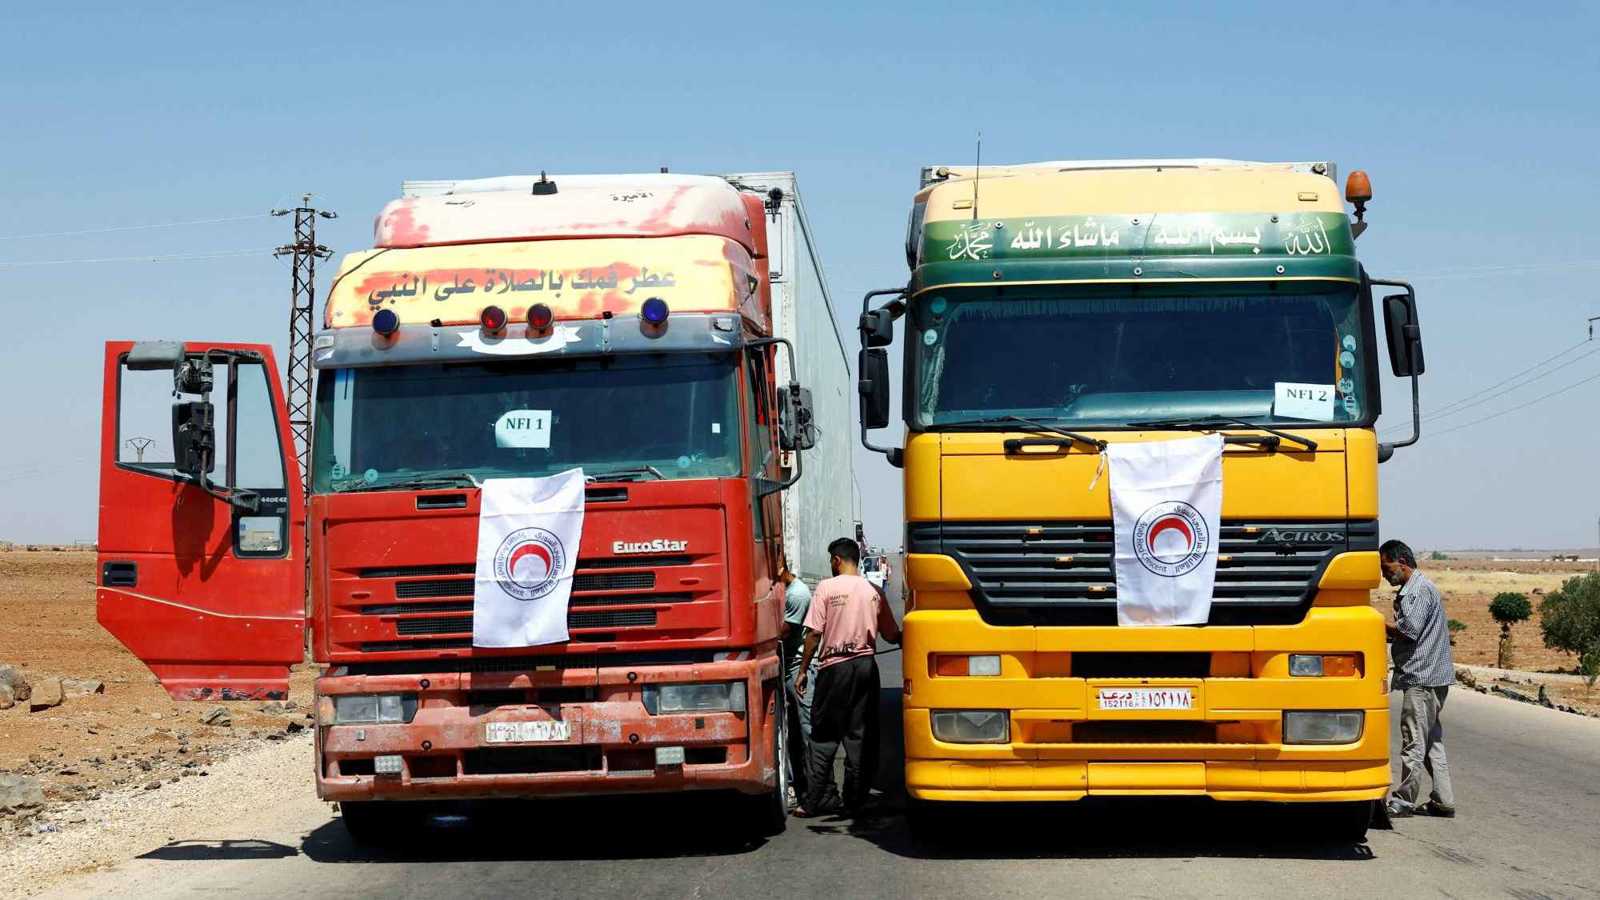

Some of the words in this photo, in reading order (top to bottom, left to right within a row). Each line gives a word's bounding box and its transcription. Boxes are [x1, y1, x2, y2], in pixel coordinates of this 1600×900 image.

[1208, 226, 1261, 255] بسم
[368, 273, 427, 311] النبي
[484, 268, 563, 298] بالصلاة
[624, 267, 676, 295] عطر
[1287, 388, 1313, 400] NFI
[1318, 390, 1327, 402] 2
[506, 417, 530, 430] NFI
[536, 418, 543, 430] 1
[613, 539, 688, 553] EuroStar
